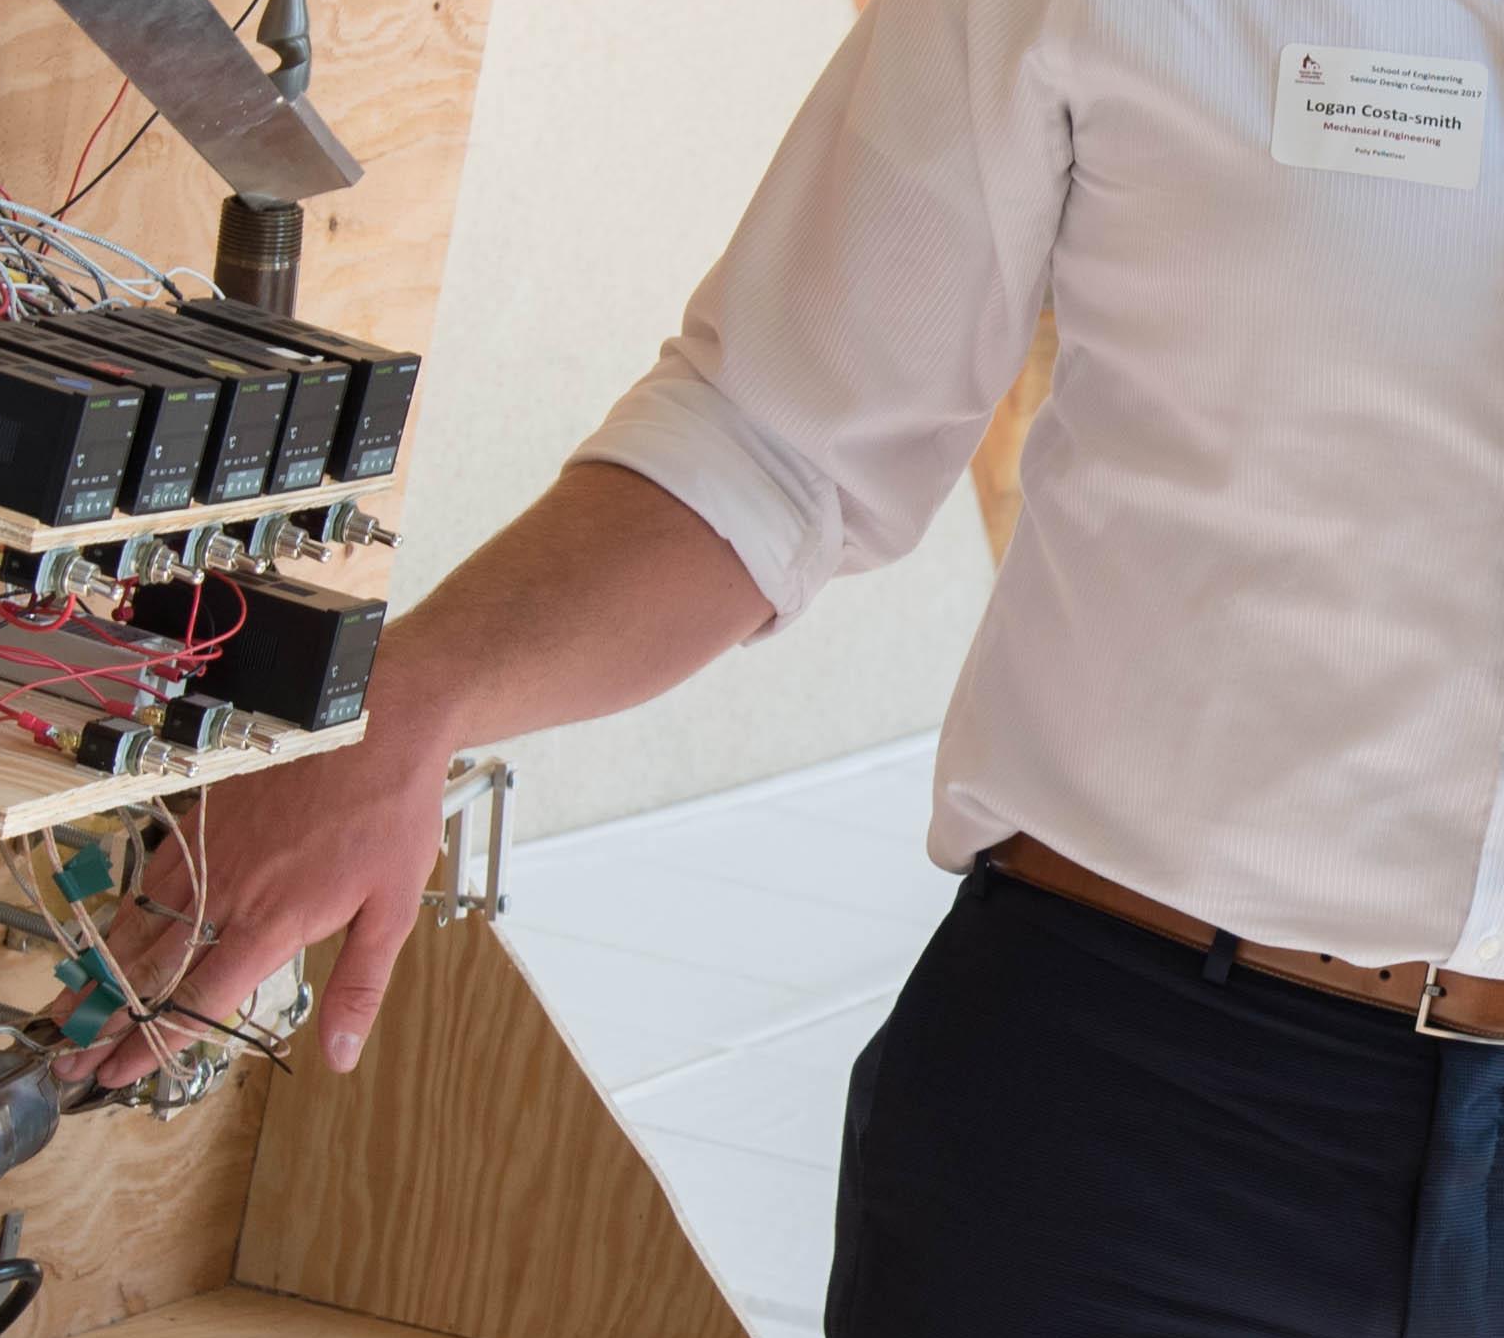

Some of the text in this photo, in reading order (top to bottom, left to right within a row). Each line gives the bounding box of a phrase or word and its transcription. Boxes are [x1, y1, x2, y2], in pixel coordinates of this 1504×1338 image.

[1350, 75, 1483, 99] Senior Design Conference 2017
[1372, 65, 1400, 76] School
[1413, 71, 1464, 85] Engineering
[1306, 99, 1462, 130] Logan Costa-smith
[1323, 122, 1441, 147] Mechanical Engineering
